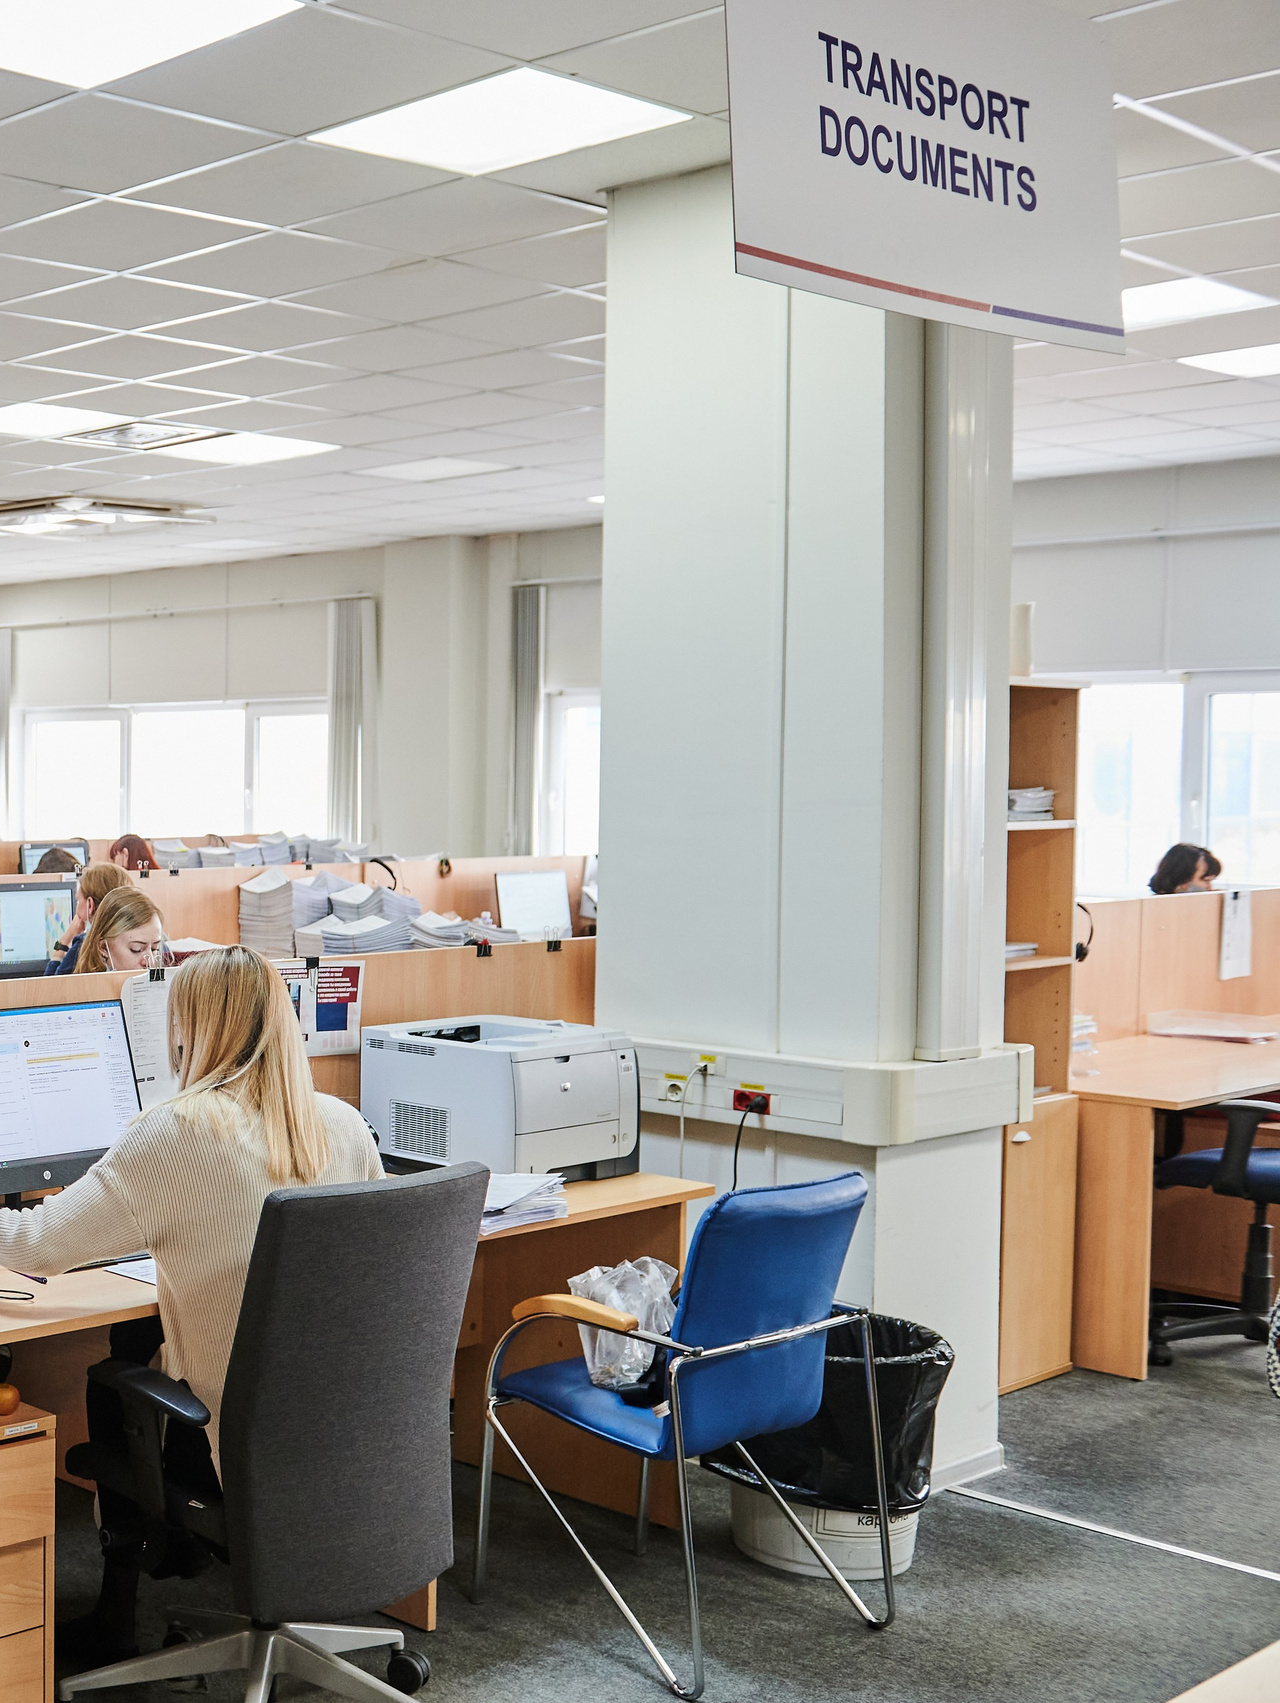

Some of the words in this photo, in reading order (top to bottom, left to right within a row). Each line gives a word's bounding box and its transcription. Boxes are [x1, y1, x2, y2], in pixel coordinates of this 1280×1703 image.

[818, 31, 1030, 143] TRANSPORT
[819, 105, 1037, 212] DOCUMENTS
[857, 1514, 909, 1528] карона
